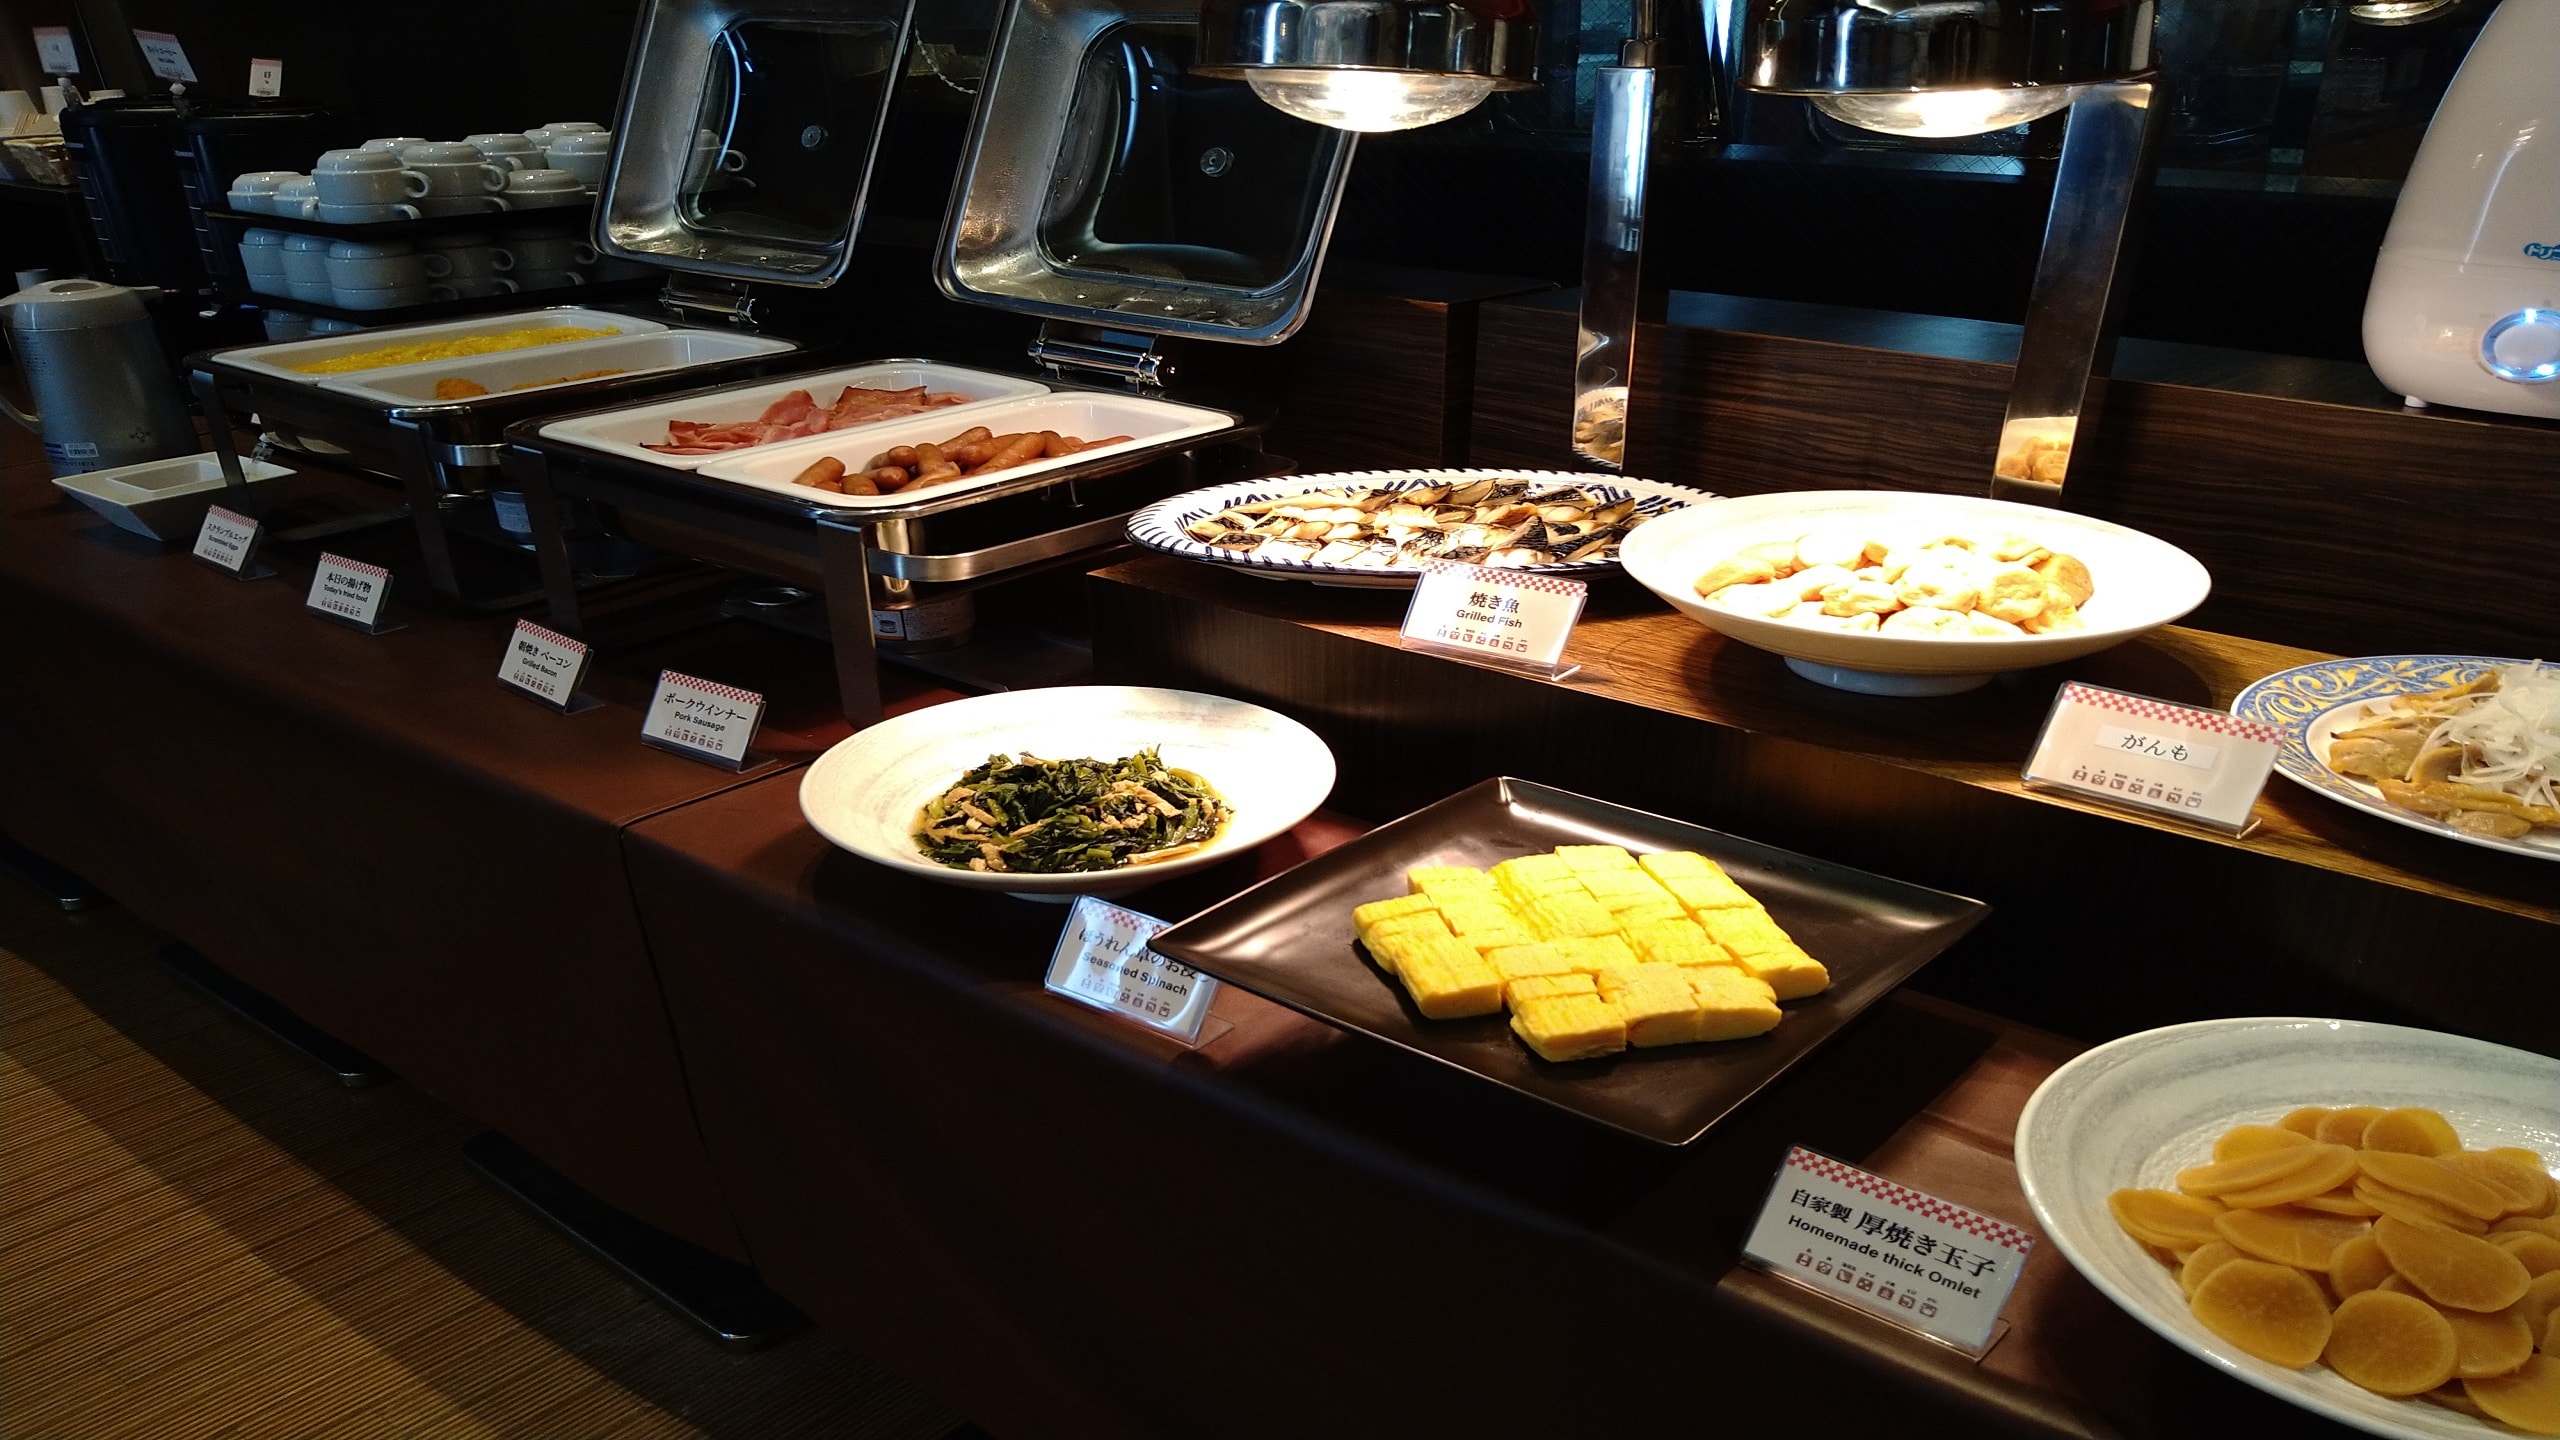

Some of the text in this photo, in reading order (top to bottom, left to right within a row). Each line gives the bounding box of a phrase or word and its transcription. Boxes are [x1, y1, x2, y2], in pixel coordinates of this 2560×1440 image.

[323, 584, 368, 603] Today's fried food
[326, 572, 372, 594] 本日の揚げ物
[1468, 591, 1519, 614] 焼き魚
[1456, 609, 1523, 629] Grilled Fish
[522, 658, 558, 678] Grilled Bacon
[541, 651, 572, 668] ベーコン
[674, 711, 726, 732] Pork Sausage
[2121, 733, 2189, 761] がんも
[1082, 952, 1139, 978] Seasoned
[1140, 972, 1188, 996] Spinach
[1790, 1188, 1853, 1223] 自家製
[1855, 1211, 1996, 1278] 厚焼き玉子
[1788, 1214, 1879, 1258] Homemade
[1883, 1252, 1925, 1277] thick
[1928, 1270, 1981, 1299] Omlet
